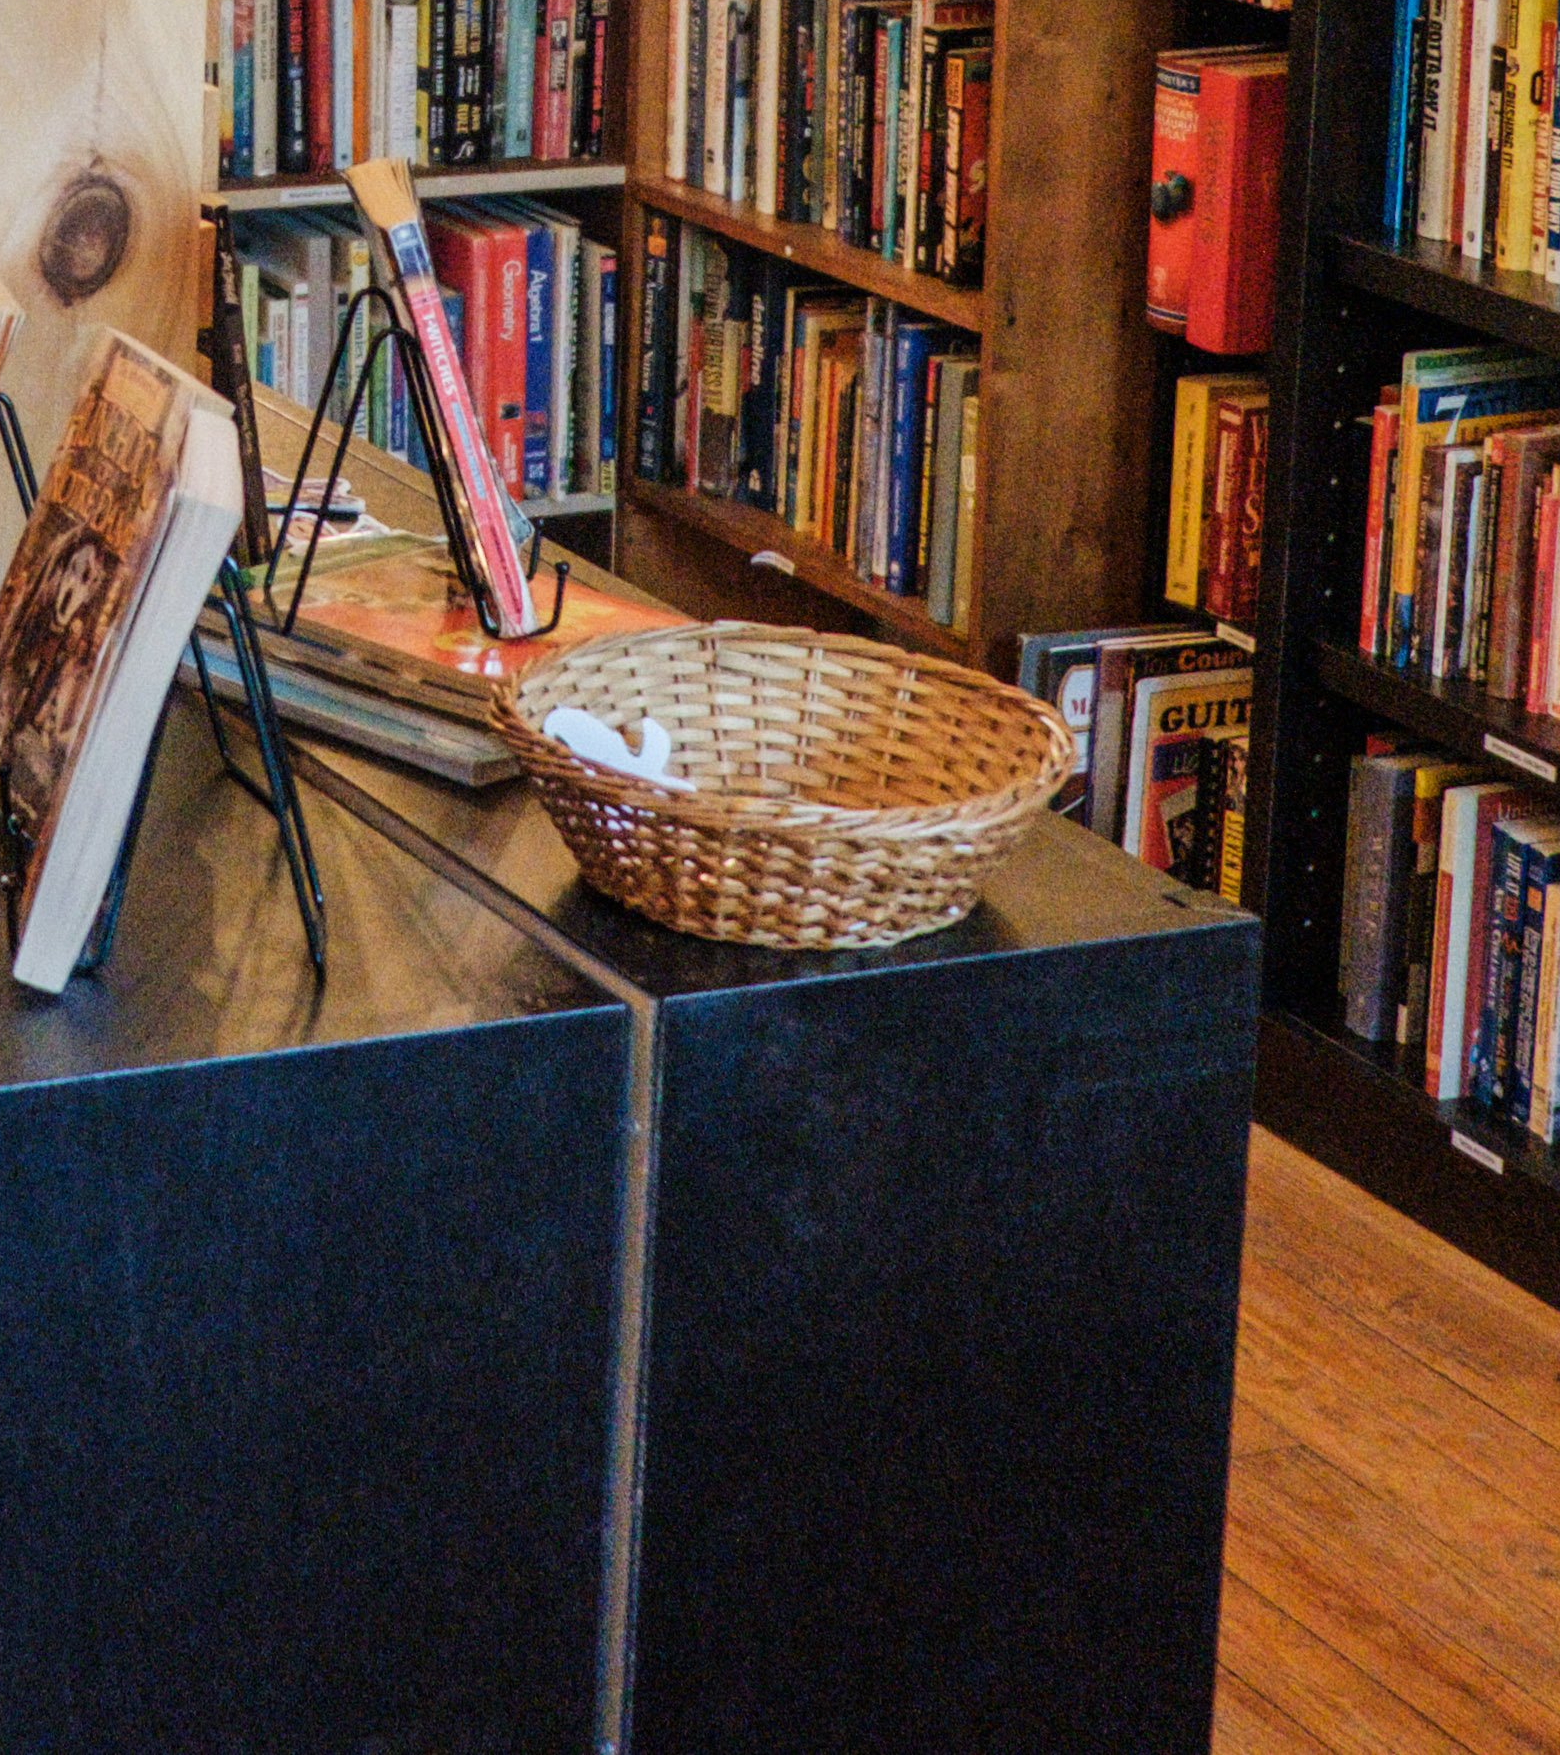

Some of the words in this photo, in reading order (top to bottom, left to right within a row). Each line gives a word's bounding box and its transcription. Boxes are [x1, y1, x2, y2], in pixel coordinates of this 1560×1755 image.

[468, 37, 480, 54] TO
[1424, 78, 1441, 111] SAY
[1503, 81, 1518, 141] CRUSHING
[456, 102, 469, 135] RULE
[470, 105, 481, 131] ANN
[501, 260, 522, 342] Geometry
[527, 269, 550, 330] Algebra
[528, 332, 542, 341] 1
[421, 312, 458, 397] T-WITCHES
